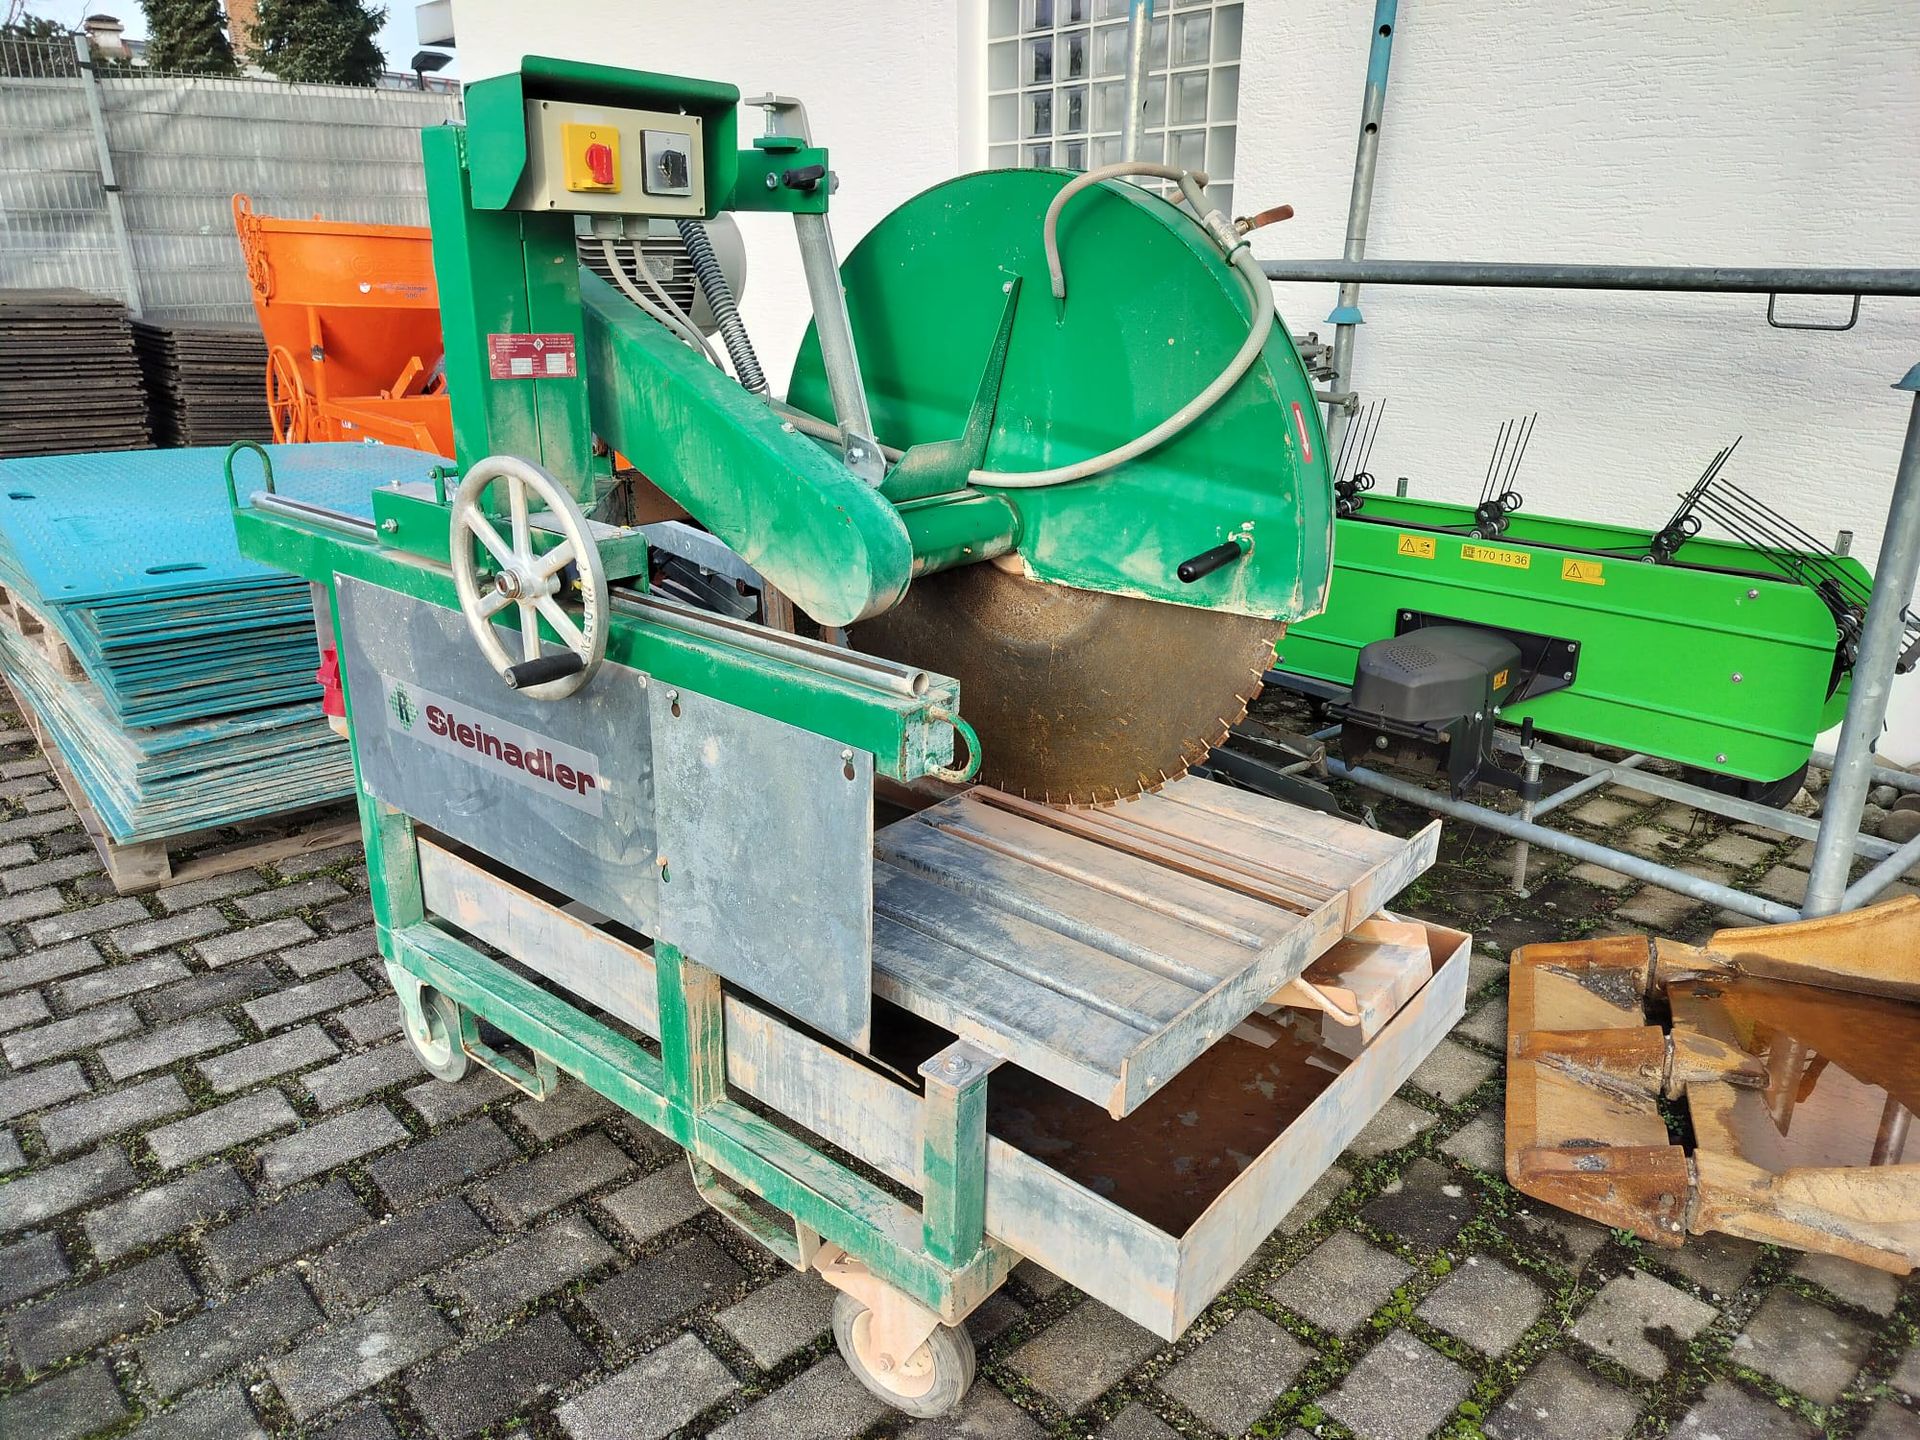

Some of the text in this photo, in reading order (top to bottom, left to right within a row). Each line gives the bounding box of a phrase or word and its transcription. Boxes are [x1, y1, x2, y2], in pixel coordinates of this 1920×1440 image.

[1477, 549, 1528, 565] 170 13 36
[425, 704, 596, 795] Steinadler
